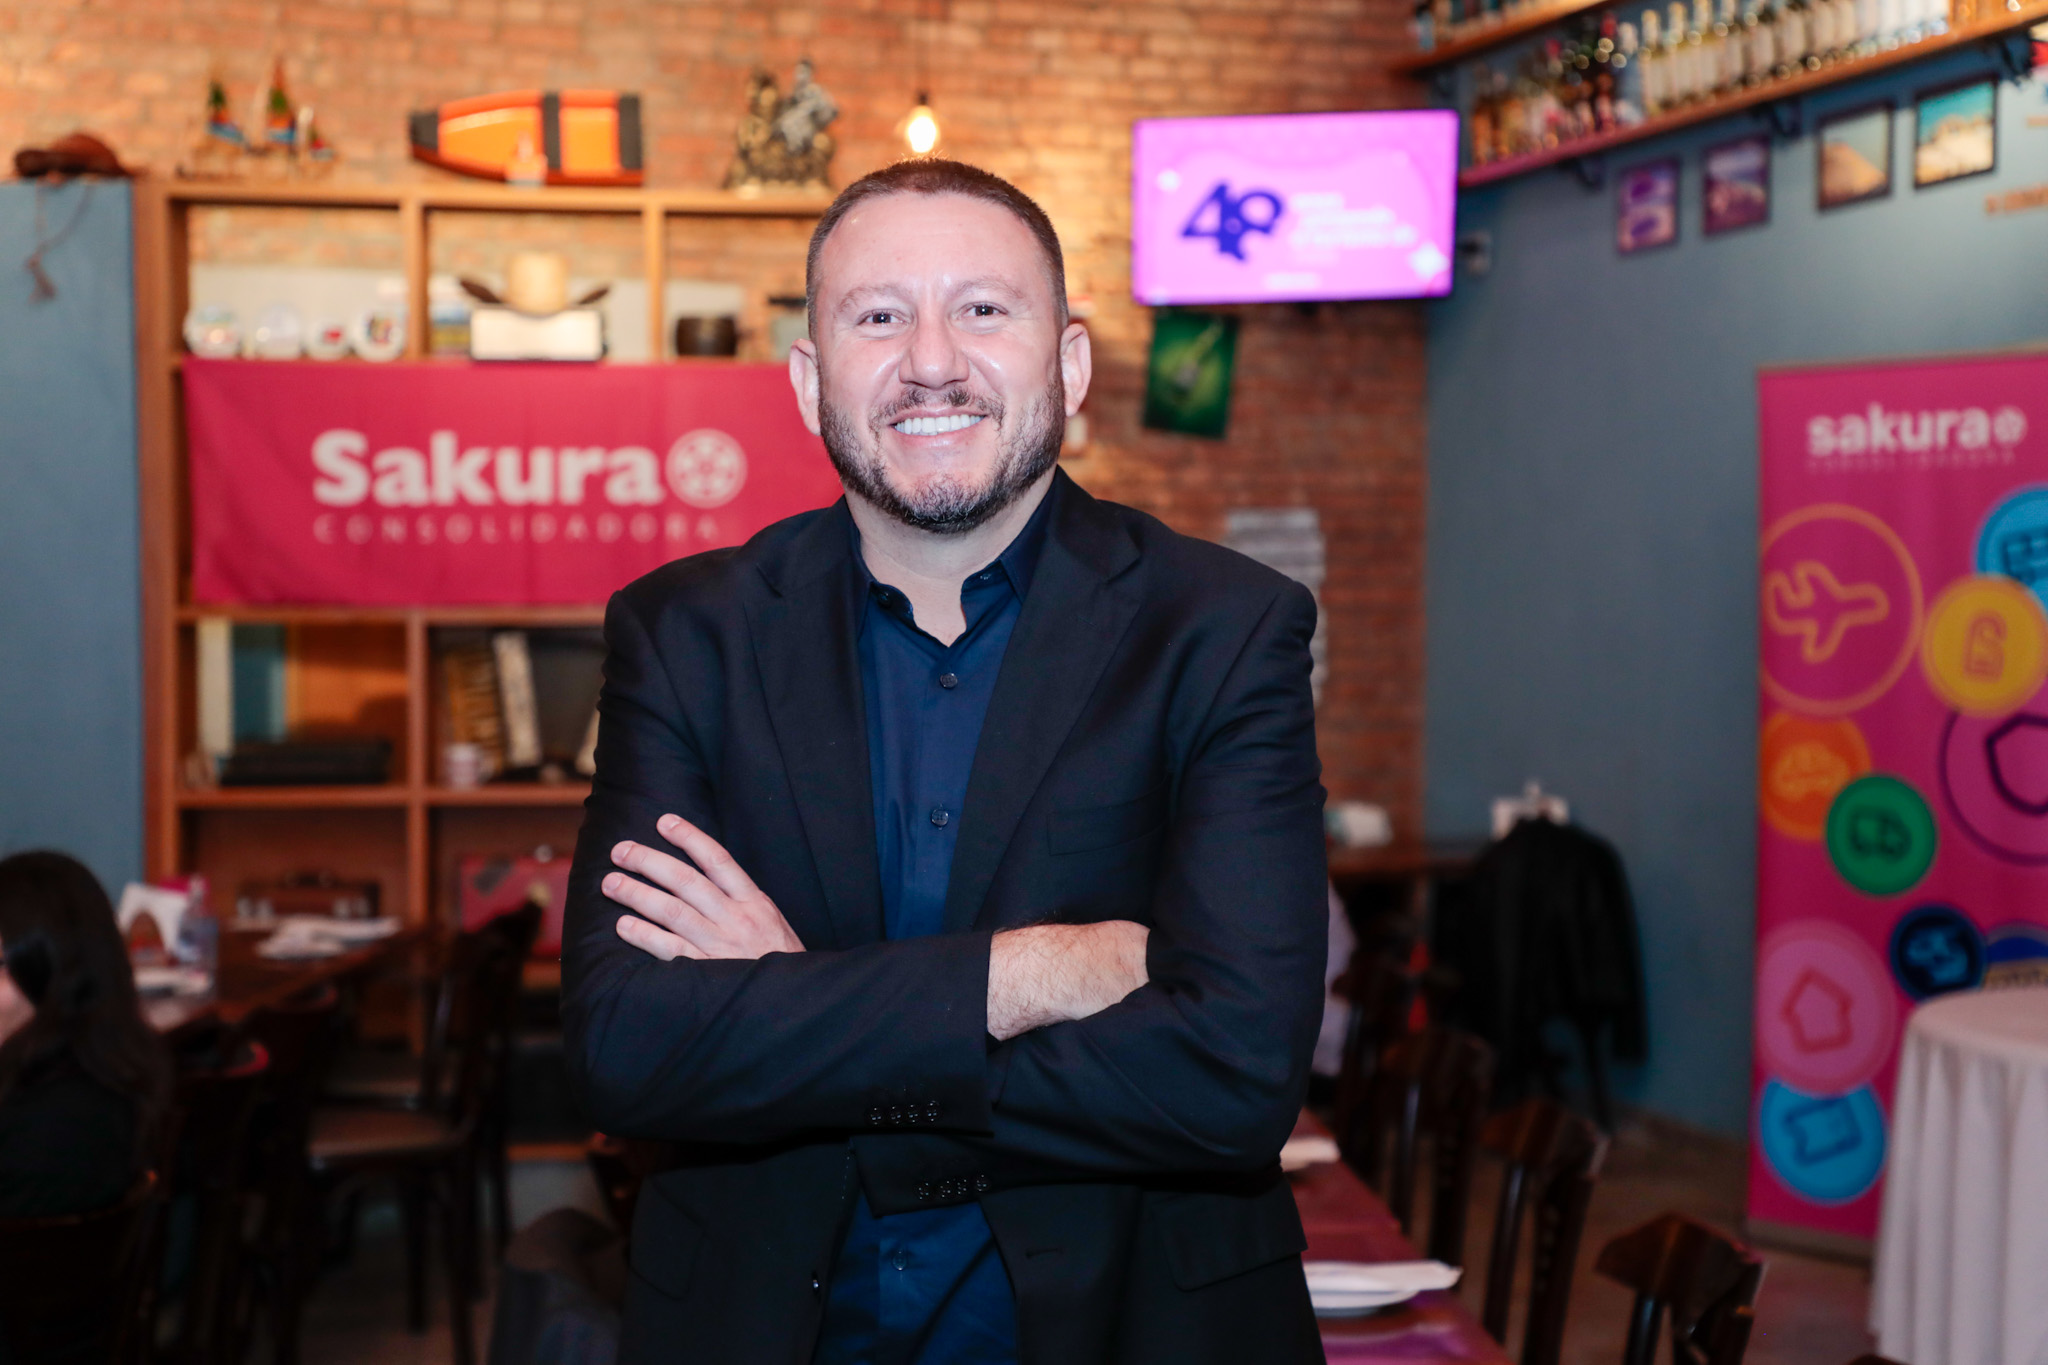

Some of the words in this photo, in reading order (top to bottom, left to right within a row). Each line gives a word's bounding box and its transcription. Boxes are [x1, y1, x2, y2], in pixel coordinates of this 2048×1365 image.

[1806, 402, 1990, 456] sakura
[311, 428, 664, 506] Sakura
[312, 511, 720, 545] CONSOLIDADORA
